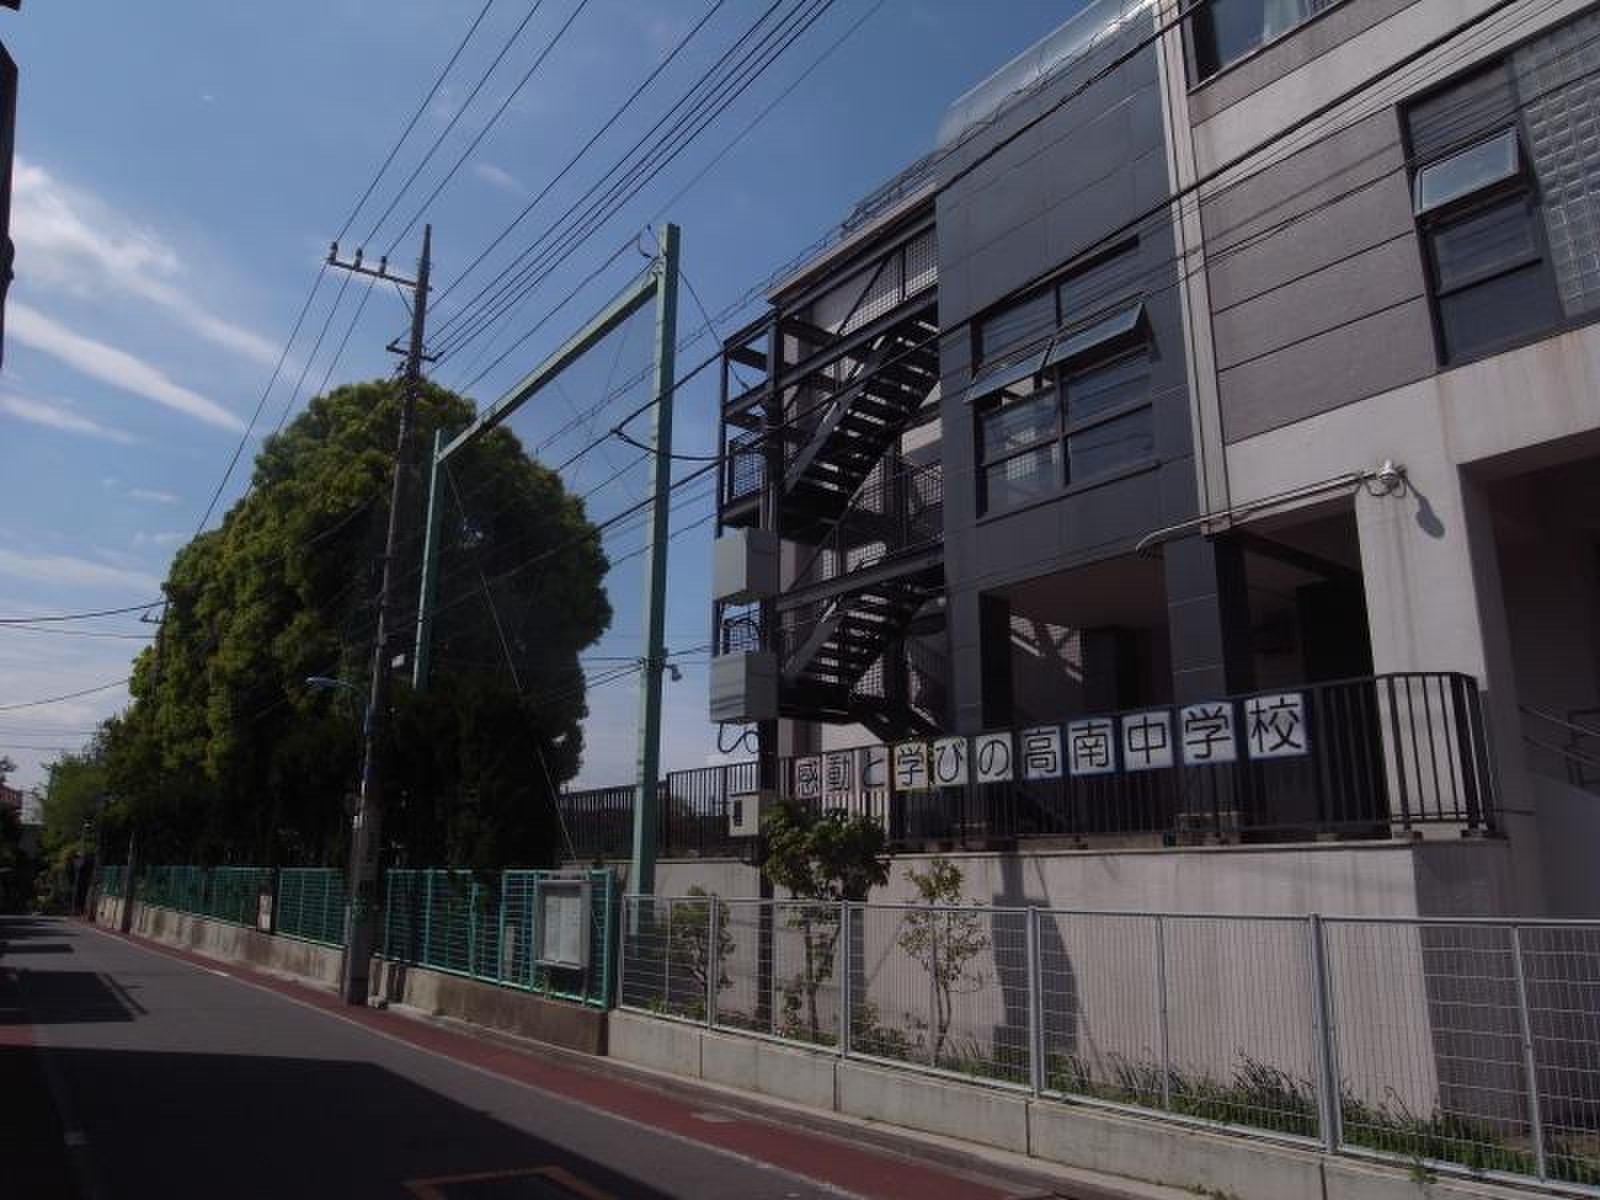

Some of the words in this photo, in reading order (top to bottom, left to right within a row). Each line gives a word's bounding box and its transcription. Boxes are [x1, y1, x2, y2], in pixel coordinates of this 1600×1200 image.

[797, 698, 1304, 797] 感動と学びの高南中学校
